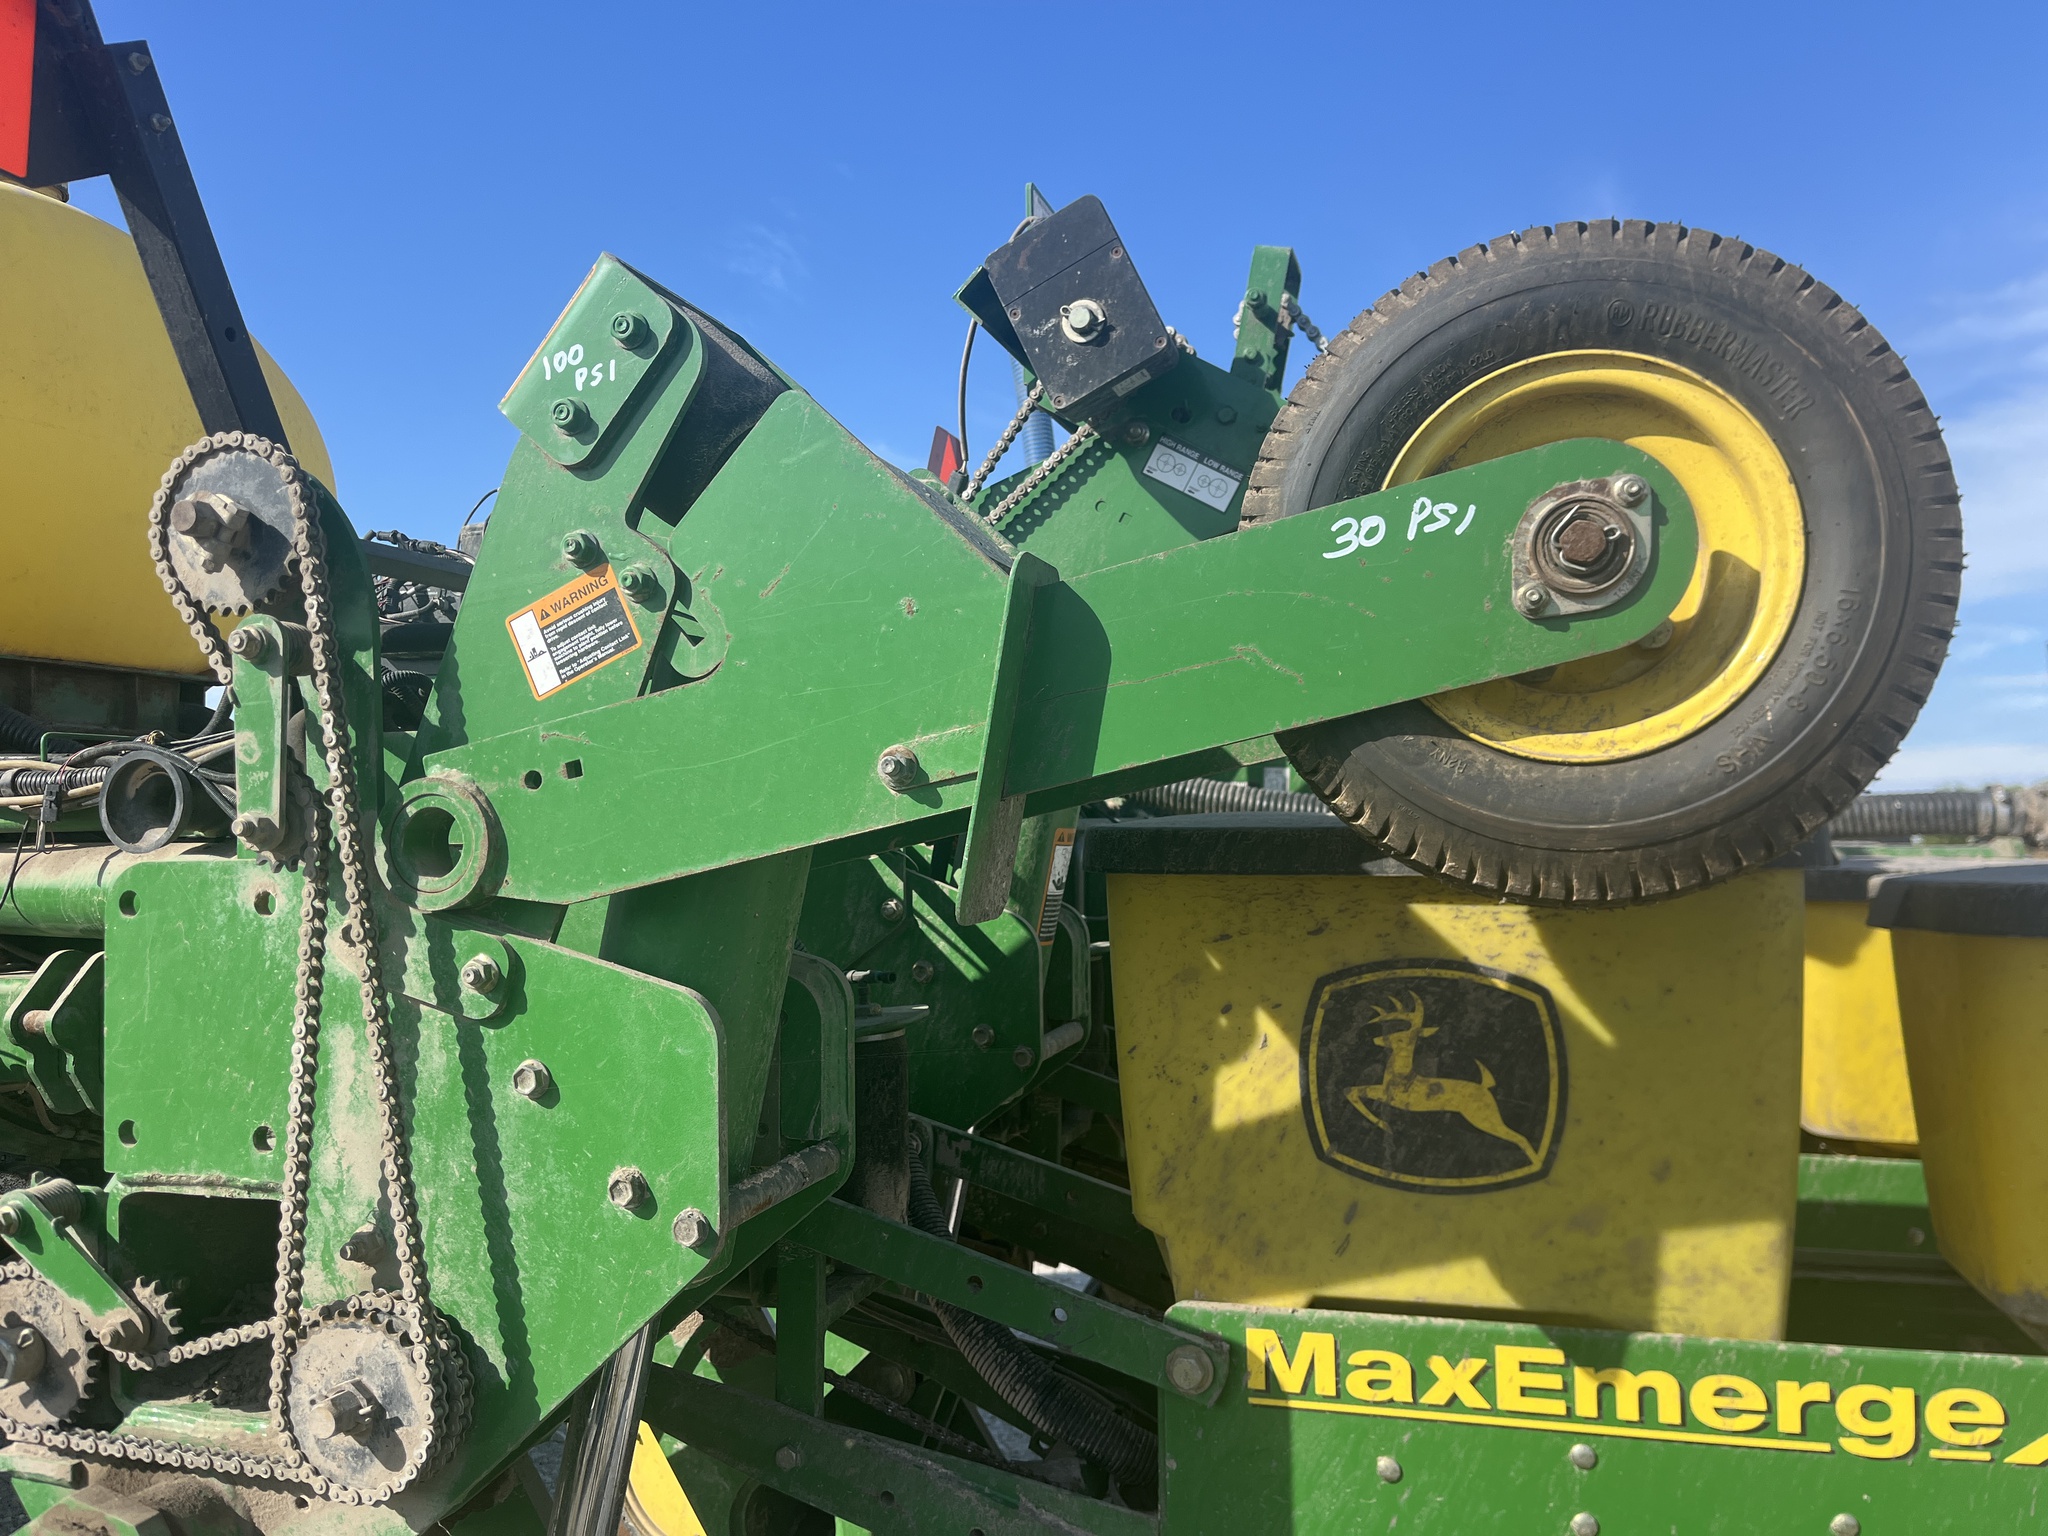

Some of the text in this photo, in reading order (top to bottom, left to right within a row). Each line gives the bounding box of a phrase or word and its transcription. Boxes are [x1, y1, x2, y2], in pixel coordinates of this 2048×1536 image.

[542, 343, 584, 381] 100
[574, 359, 616, 391] PSI
[1468, 350, 1496, 368] COLD
[1638, 299, 1816, 421] RUBBERMASTER
[1348, 357, 1453, 484] RATING TUBELESS NYLON
[1159, 435, 1200, 460] HIGH RANGE
[1203, 457, 1244, 481] LOW RANGE
[1323, 514, 1387, 560] 30
[550, 575, 608, 613] WARNING
[543, 597, 606, 634] Avoid serious crushing injury
[545, 631, 556, 639] from
[556, 624, 568, 633] rapid
[568, 614, 585, 626] descent
[591, 601, 608, 613] contact
[1813, 610, 1829, 632] NOT
[552, 639, 579, 657] engagement
[594, 625, 605, 634] fully
[605, 618, 618, 628] lower
[554, 648, 573, 661] machine
[579, 638, 590, 649] plant
[590, 629, 608, 642] position
[608, 621, 623, 632] before
[555, 640, 599, 666] loosening hardware.
[557, 639, 571, 649] adjust
[571, 629, 588, 641] contact
[587, 624, 597, 632] link
[559, 665, 572, 674] Refer
[577, 650, 601, 664] "Adjusting
[601, 640, 619, 652] Contact
[618, 632, 631, 642] Link"
[1800, 637, 1817, 658] FOR
[574, 657, 598, 672] Operator's
[1730, 703, 1768, 737] SERVICE
[1245, 1327, 2006, 1460] MaxEmerge
